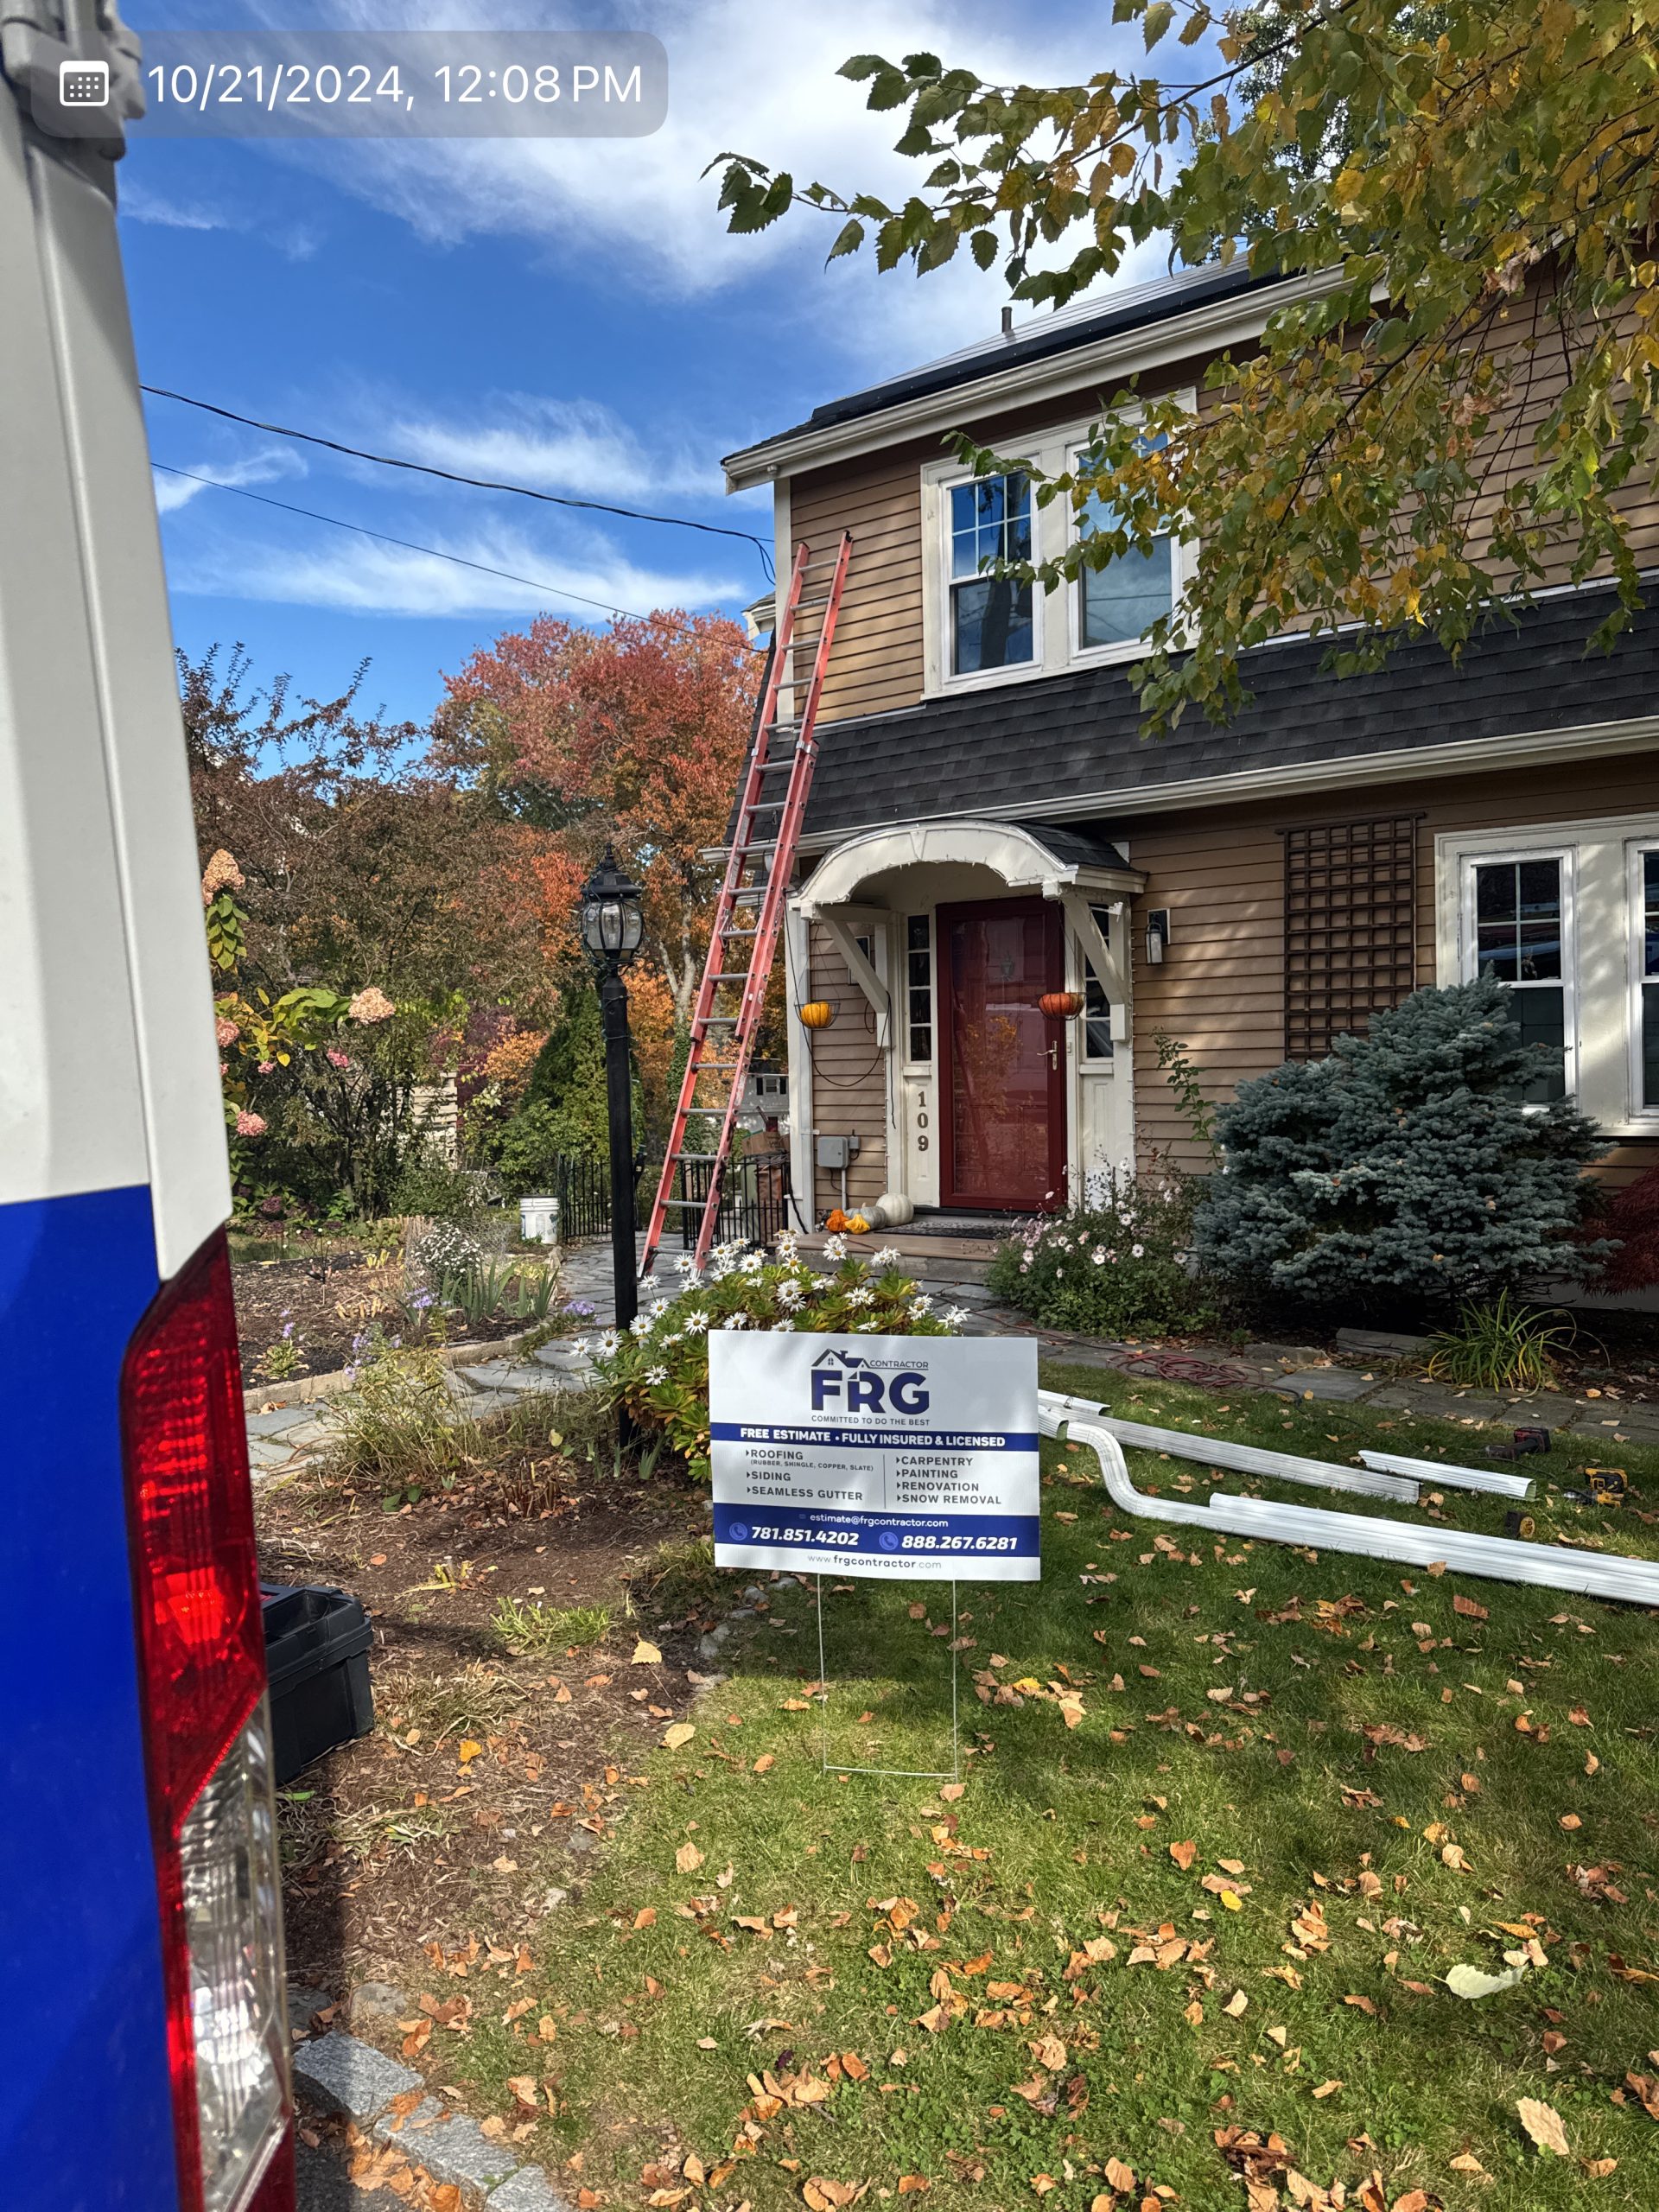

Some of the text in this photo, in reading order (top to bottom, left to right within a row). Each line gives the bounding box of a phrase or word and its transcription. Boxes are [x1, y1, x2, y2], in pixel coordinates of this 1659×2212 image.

[917, 1090, 929, 1152] 109
[869, 1359, 929, 1369] CONTRACTOR
[810, 1369, 930, 1415] FRG
[811, 1414, 859, 1424] COMMITTED
[740, 1427, 1006, 1447] FREE ESTIMATE FULLY INSURED & LICENSED
[750, 1449, 804, 1460] ROOFING
[901, 1456, 974, 1466] CARPENTRY
[751, 1471, 791, 1481] SIDING
[901, 1469, 958, 1479] PAINTING
[902, 1482, 979, 1491] RENOVATION
[752, 1486, 863, 1501] SEAMLESS GUTTER
[902, 1494, 1001, 1504] SNOW REMOVAL
[810, 1514, 949, 1528] estimate@frgcontractor.com
[751, 1526, 860, 1546] 781.851.4202
[901, 1535, 1018, 1550] 888.267.6281
